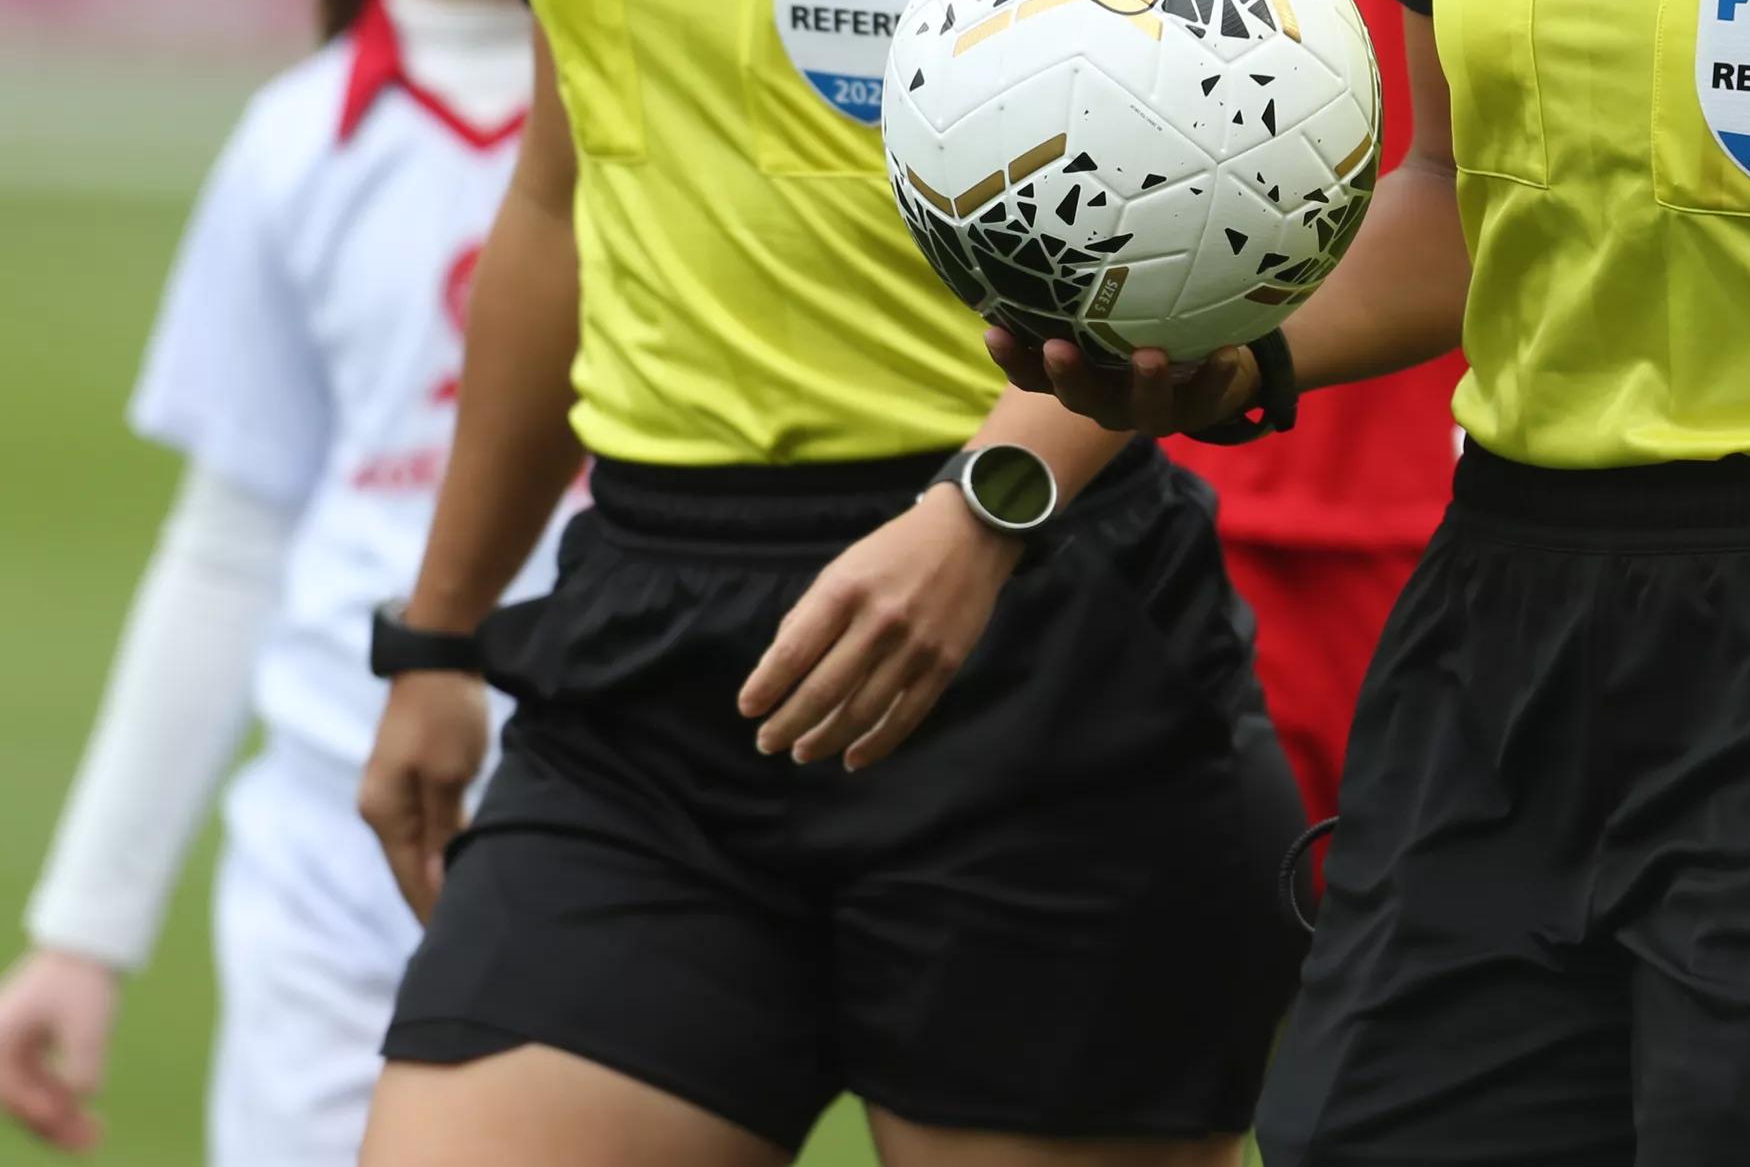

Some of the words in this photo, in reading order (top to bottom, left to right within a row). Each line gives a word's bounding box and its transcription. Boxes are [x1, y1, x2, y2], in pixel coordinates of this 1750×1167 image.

[791, 5, 904, 37] REFER
[834, 79, 883, 104] 202
[1099, 279, 1118, 304] SIZE
